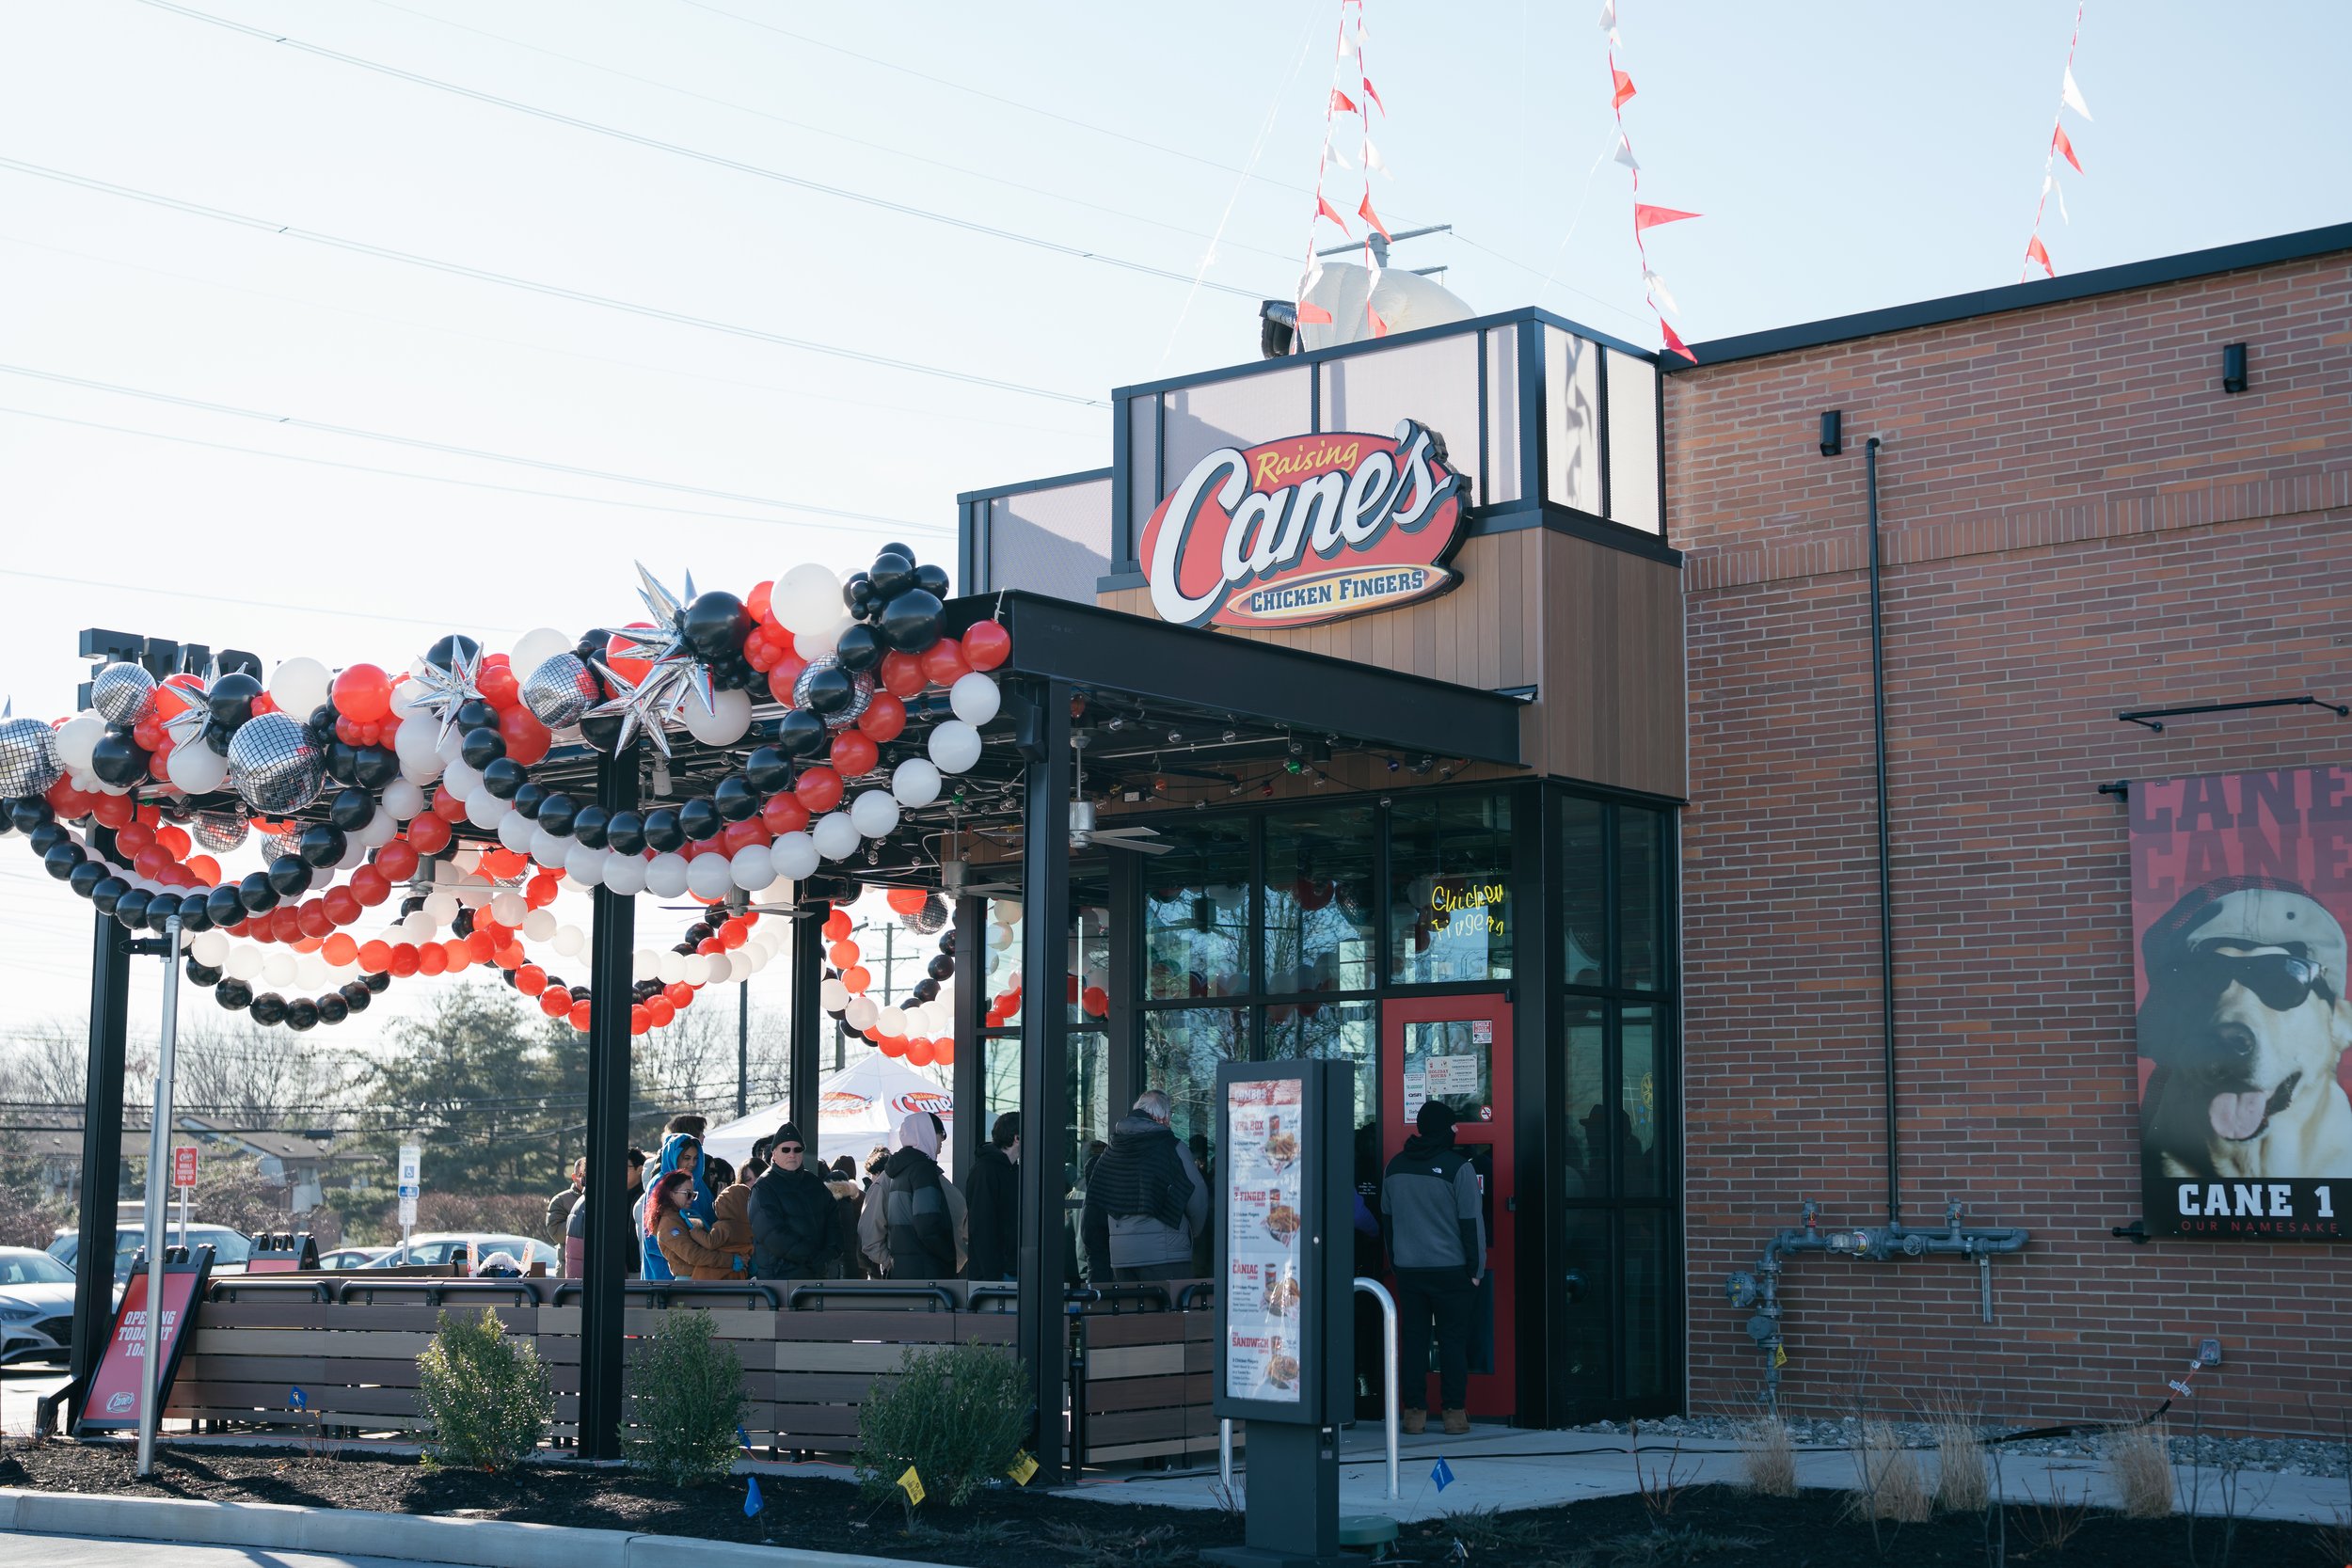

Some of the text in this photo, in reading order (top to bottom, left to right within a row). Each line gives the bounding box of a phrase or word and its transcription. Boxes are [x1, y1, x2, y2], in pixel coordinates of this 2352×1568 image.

[1254, 440, 1359, 487] Raising
[1150, 418, 1454, 625] Cane's
[1250, 570, 1423, 612] CHICKEN FINGERS
[2128, 766, 2352, 834] CANE
[1432, 884, 1504, 912] Chicken
[894, 1093, 953, 1114] Cane'
[2178, 1183, 2334, 1218] CANE 1
[2181, 1220, 2339, 1233] OUR NAMESAKE
[1232, 1264, 1258, 1274] CANIAC
[124, 1310, 177, 1325] OPENG
[118, 1326, 147, 1340] TODA
[1232, 1337, 1269, 1348] SANDWICH
